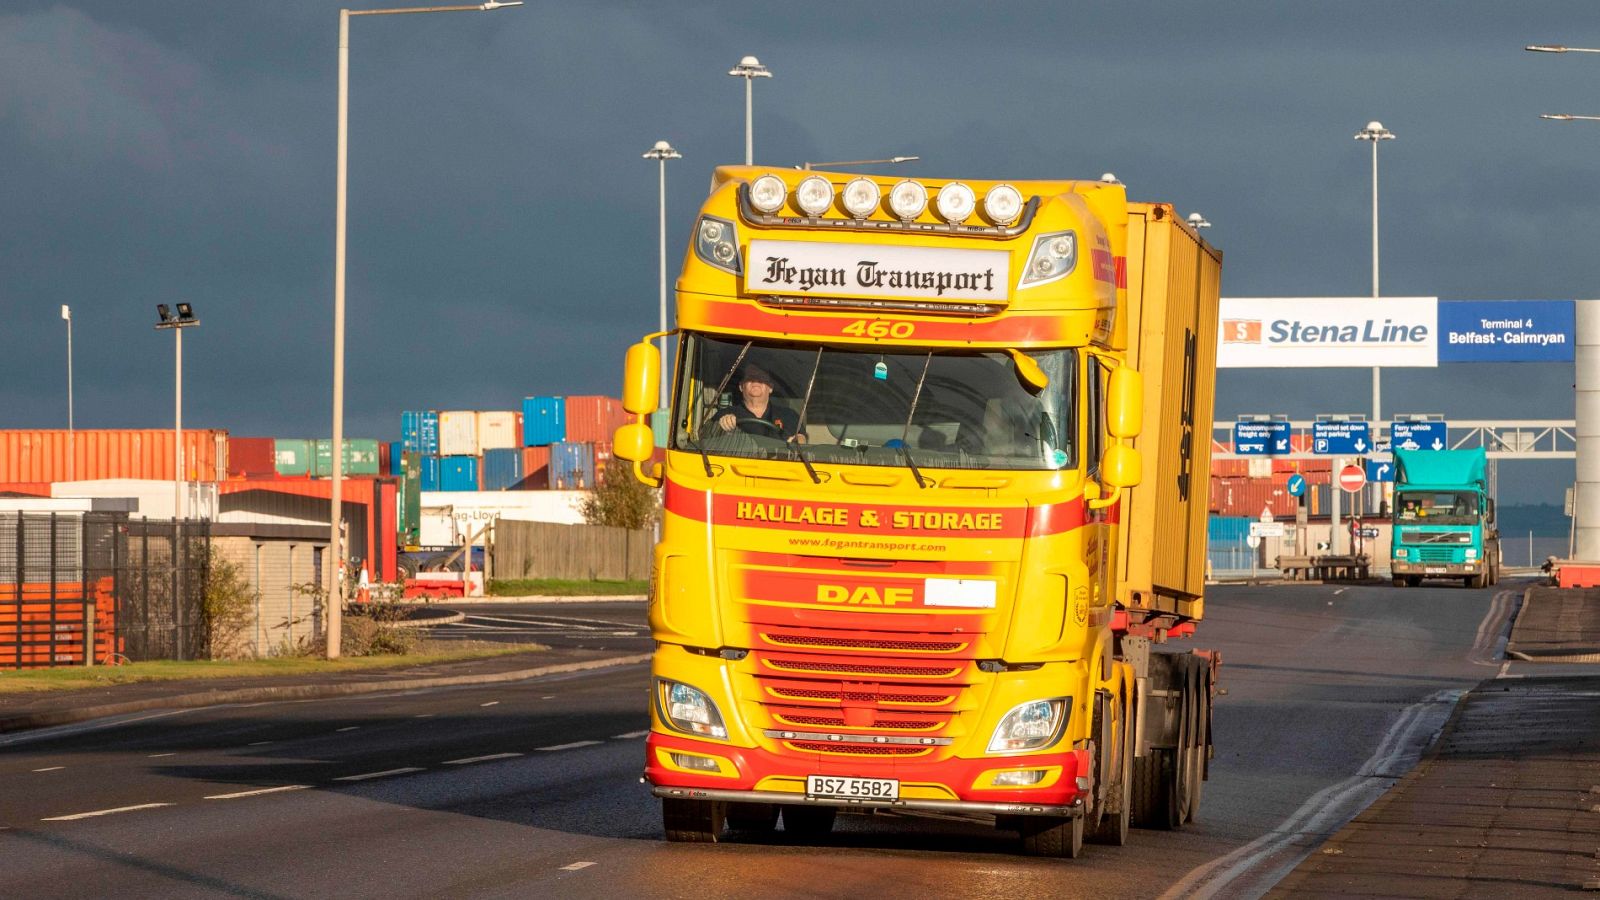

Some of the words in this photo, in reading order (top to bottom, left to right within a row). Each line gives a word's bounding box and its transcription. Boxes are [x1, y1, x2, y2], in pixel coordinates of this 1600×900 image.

[762, 256, 847, 291] Fegan
[856, 260, 994, 296] Transport
[841, 319, 915, 338] 460
[1268, 319, 1359, 343] Stena
[1362, 319, 1429, 343] Line
[1480, 318, 1523, 329] Terminal
[1525, 318, 1533, 329] 4
[1449, 332, 1495, 344] Belfast
[1503, 332, 1565, 346] Cairnryan
[1259, 431, 1271, 439] only
[1328, 431, 1350, 439] parking
[1394, 424, 1409, 432] Ferry
[736, 501, 849, 526] HAULAGE
[859, 510, 881, 528] &
[893, 511, 1003, 530] STORAGE
[788, 538, 946, 552] www.fegantransport.com
[816, 584, 914, 606] DAF
[813, 778, 846, 794] BSZ
[850, 780, 893, 797] 5582
